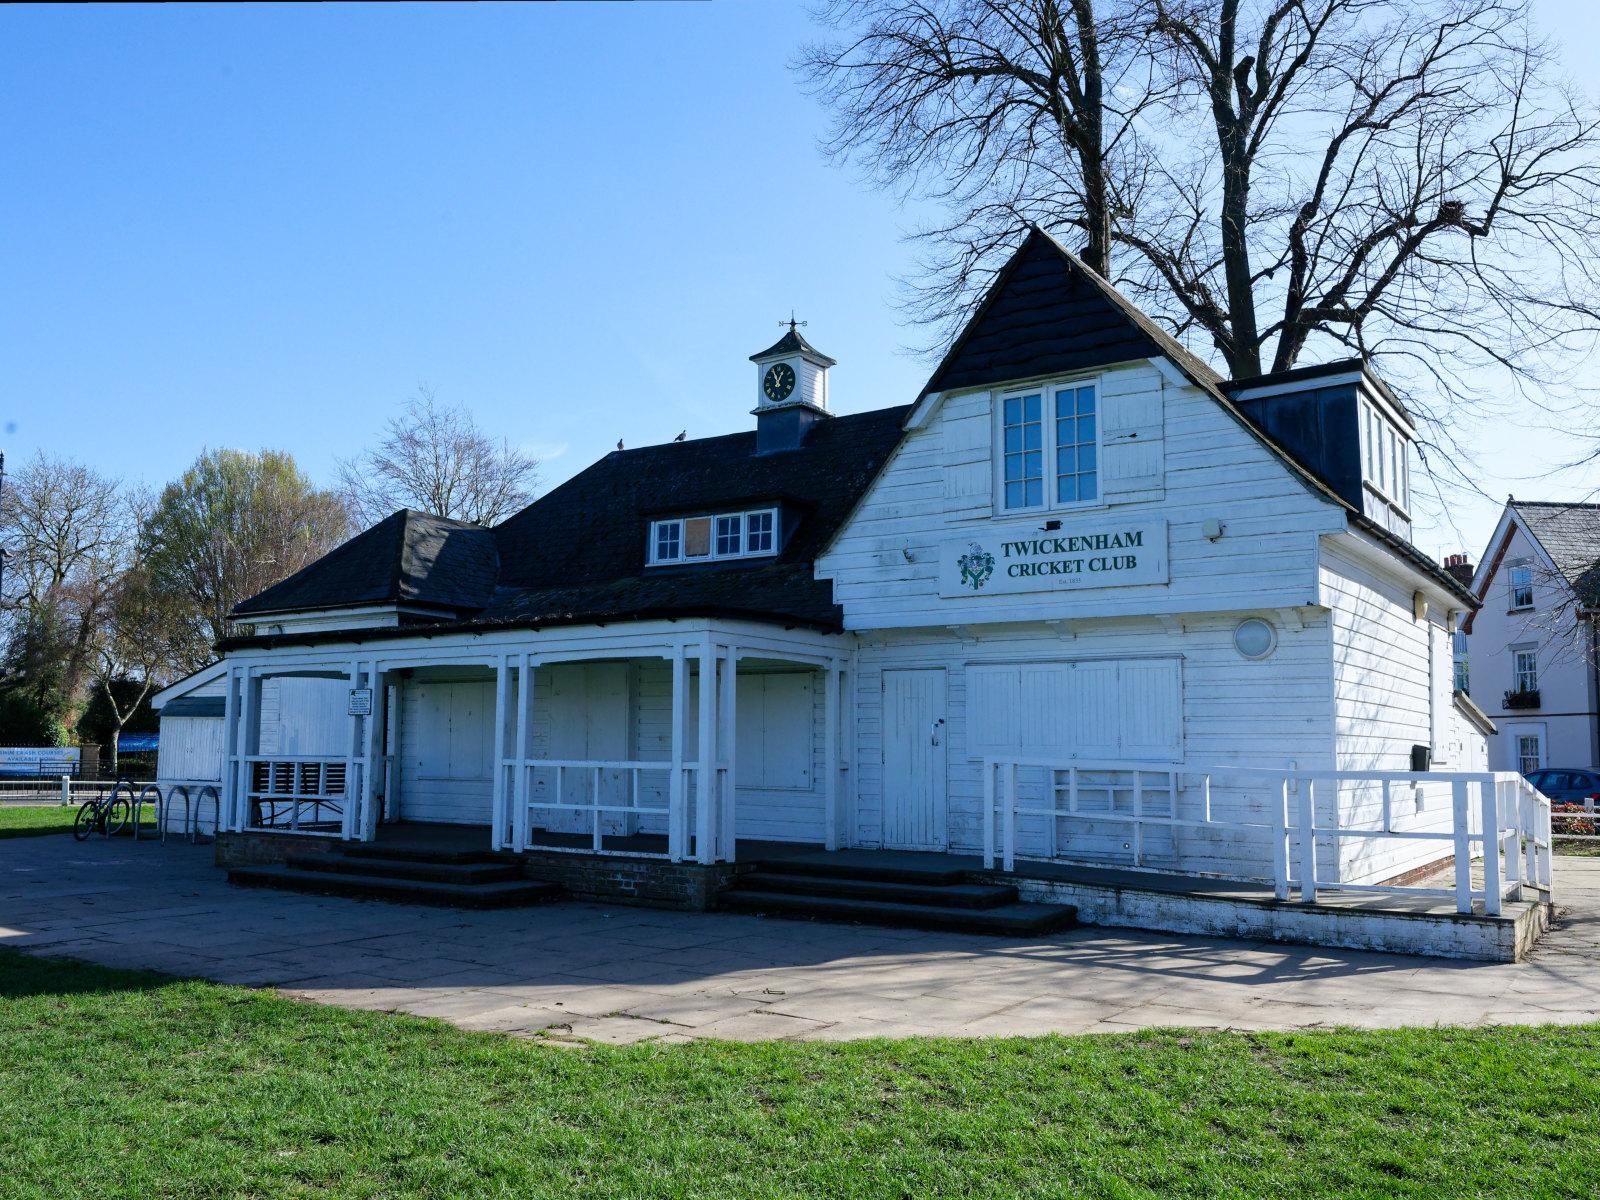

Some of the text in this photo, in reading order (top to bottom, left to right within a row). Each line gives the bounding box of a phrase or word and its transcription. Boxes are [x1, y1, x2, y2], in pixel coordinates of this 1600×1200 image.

[1001, 531, 1144, 558] TWICKENHAM
[1007, 555, 1137, 578] CRICKET CLUB
